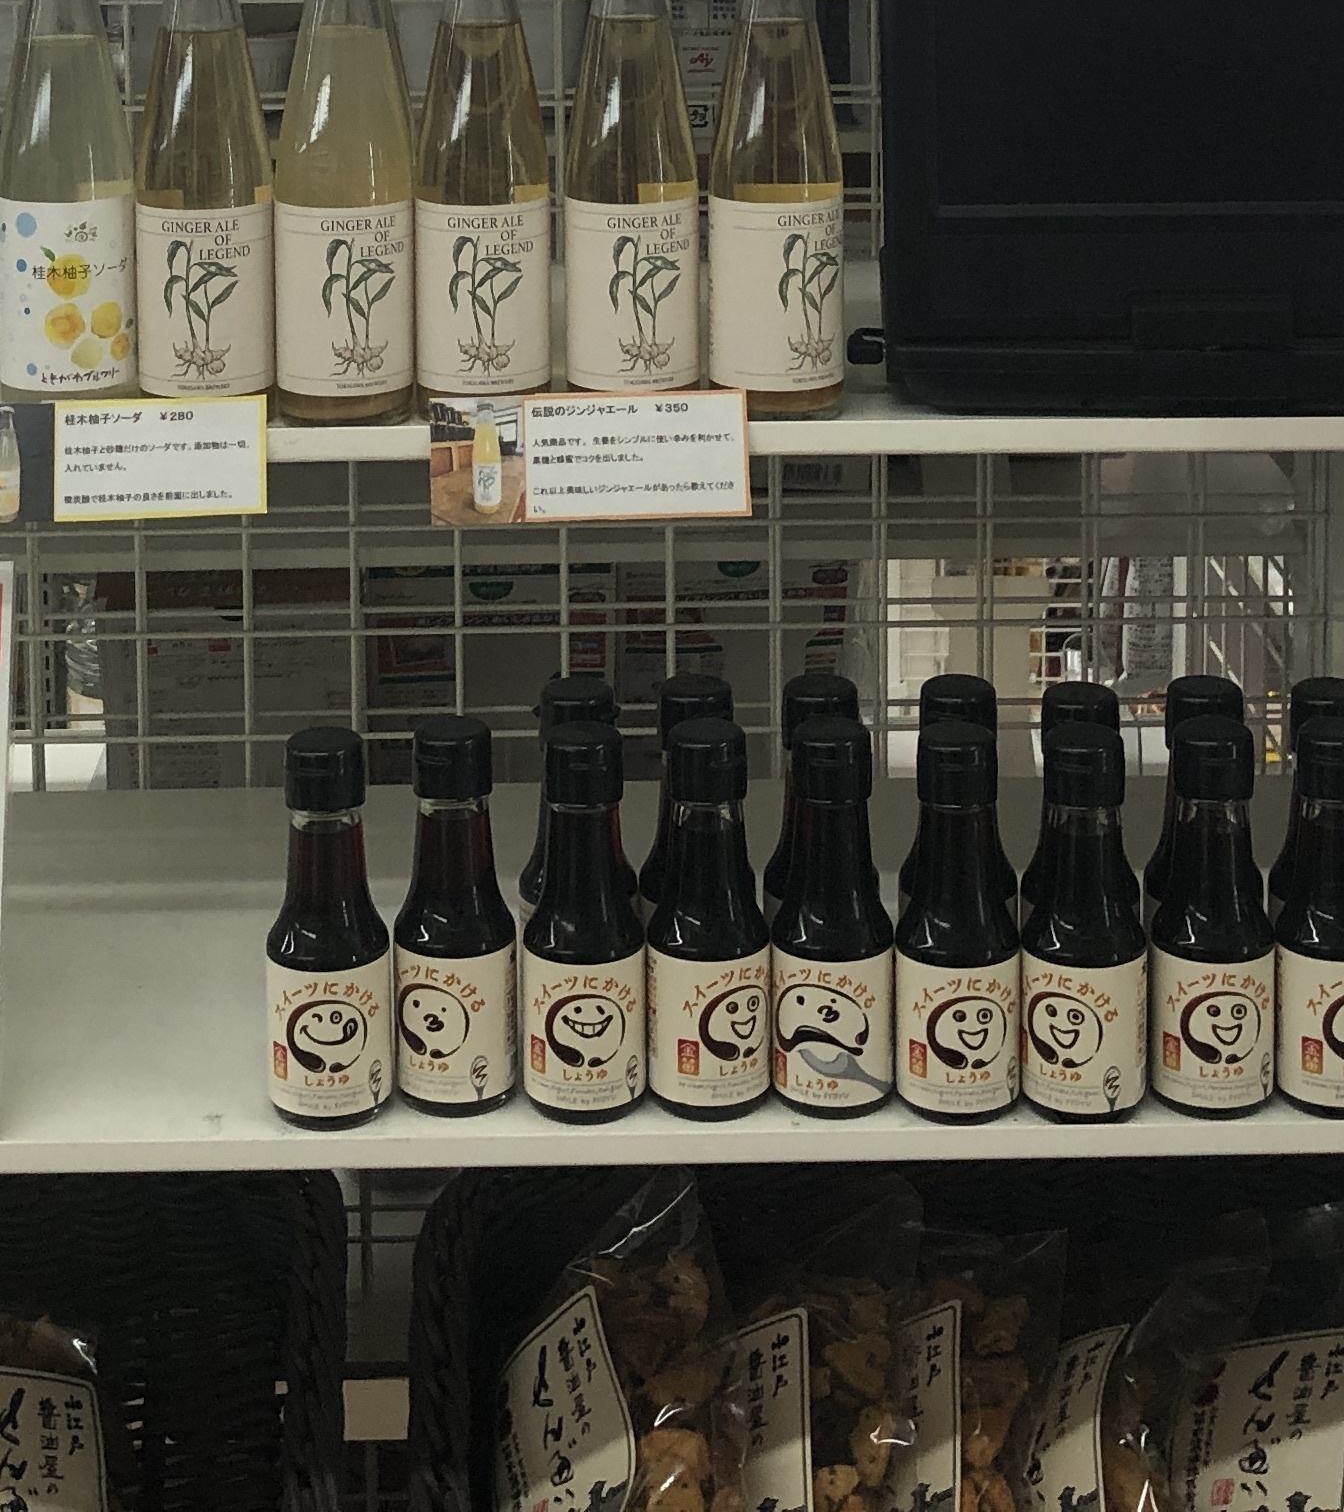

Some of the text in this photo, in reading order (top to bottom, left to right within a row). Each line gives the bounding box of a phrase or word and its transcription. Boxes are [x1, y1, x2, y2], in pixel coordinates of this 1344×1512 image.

[161, 219, 240, 234] GINGER ALE
[320, 215, 397, 232] GINGER ALE
[447, 214, 525, 229] GINGER ALE
[607, 213, 682, 229] GINGER ALE
[777, 213, 825, 228] GINGER
[374, 230, 391, 243] OF
[500, 229, 518, 242] OF
[660, 228, 677, 241] OF
[825, 224, 837, 236] OF
[214, 233, 232, 246] OF
[646, 239, 691, 255] LEGEND
[199, 245, 251, 261] LEGEND
[360, 241, 405, 258] LEGEND
[485, 240, 534, 256] LEGEND
[32, 257, 129, 281] 桂木柚子ソーダ
[64, 410, 194, 426] 桂木柚子ソーダ ¥280
[531, 402, 689, 418] 伝説のジンジャエール ¥350
[64, 462, 127, 473] 入れていません。
[397, 964, 486, 1014] ーツにかける
[533, 974, 636, 1014] スイーツにかける
[276, 980, 380, 1019] スイーツにかける
[912, 977, 1016, 1018] スイーツにかける
[409, 1058, 451, 1073] しょうゆ
[720, 1060, 758, 1077] しょうゆ
[1199, 1065, 1244, 1081] しょうゆ
[304, 1073, 351, 1088] しょうゆ
[563, 1067, 601, 1082] しょうゆ
[795, 1074, 840, 1090] しょうゆ
[945, 1069, 991, 1084] しょうゆ
[1039, 1067, 1082, 1083] しょうゆ
